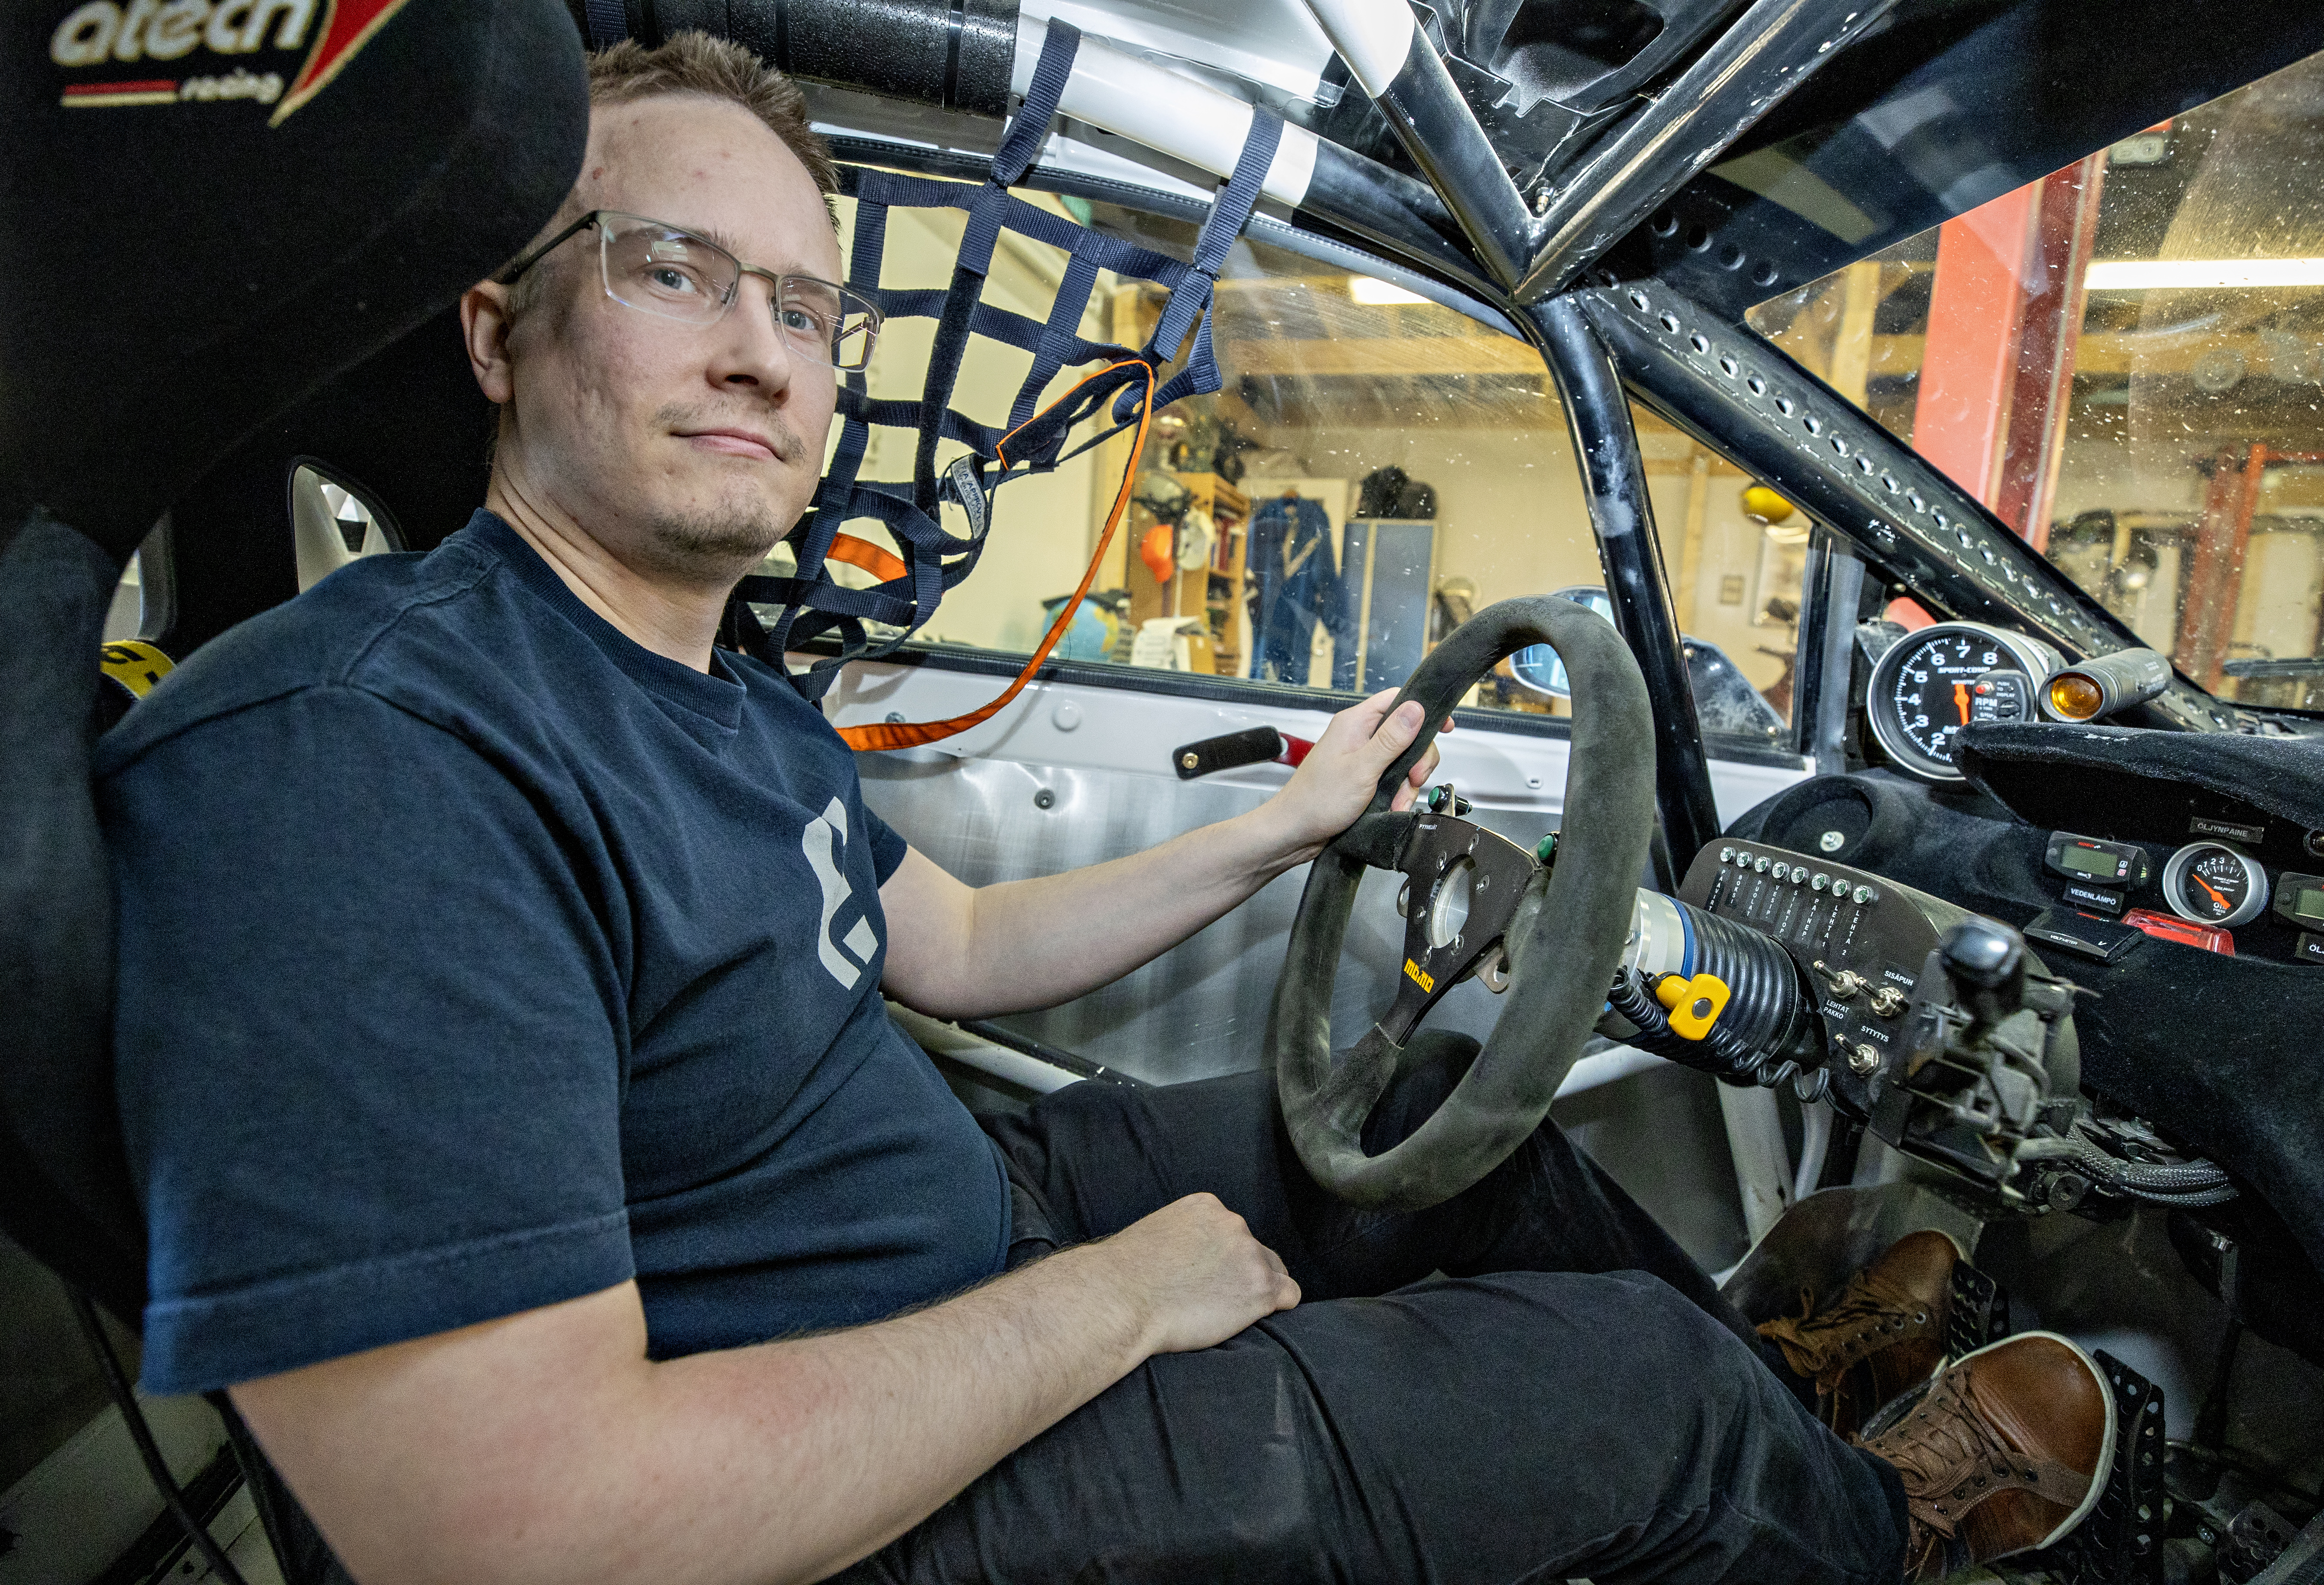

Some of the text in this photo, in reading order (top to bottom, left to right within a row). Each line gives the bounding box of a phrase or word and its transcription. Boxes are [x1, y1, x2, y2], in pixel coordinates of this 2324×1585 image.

[179, 67, 284, 103] racing
[960, 465, 969, 480] FIA
[1955, 645, 1971, 658] 7
[1982, 652, 1998, 665] 8
[1931, 653, 1946, 666] 6
[1914, 670, 1928, 683] 5
[1908, 693, 1921, 706] 4
[1975, 697, 1998, 707] RPM
[1915, 714, 1929, 727] 3
[1931, 732, 1946, 746] 2
[1730, 875, 1743, 904] BOKSI
[2070, 888, 2116, 905] VEDENLÄMPÖ
[1747, 880, 1762, 916] PUOLAT
[1884, 970, 1914, 986] SISÄPUH
[1823, 1006, 1844, 1020] PAKKO
[1826, 999, 1850, 1013] LEHTAT
[1861, 1025, 1890, 1043] SYTYTYS
